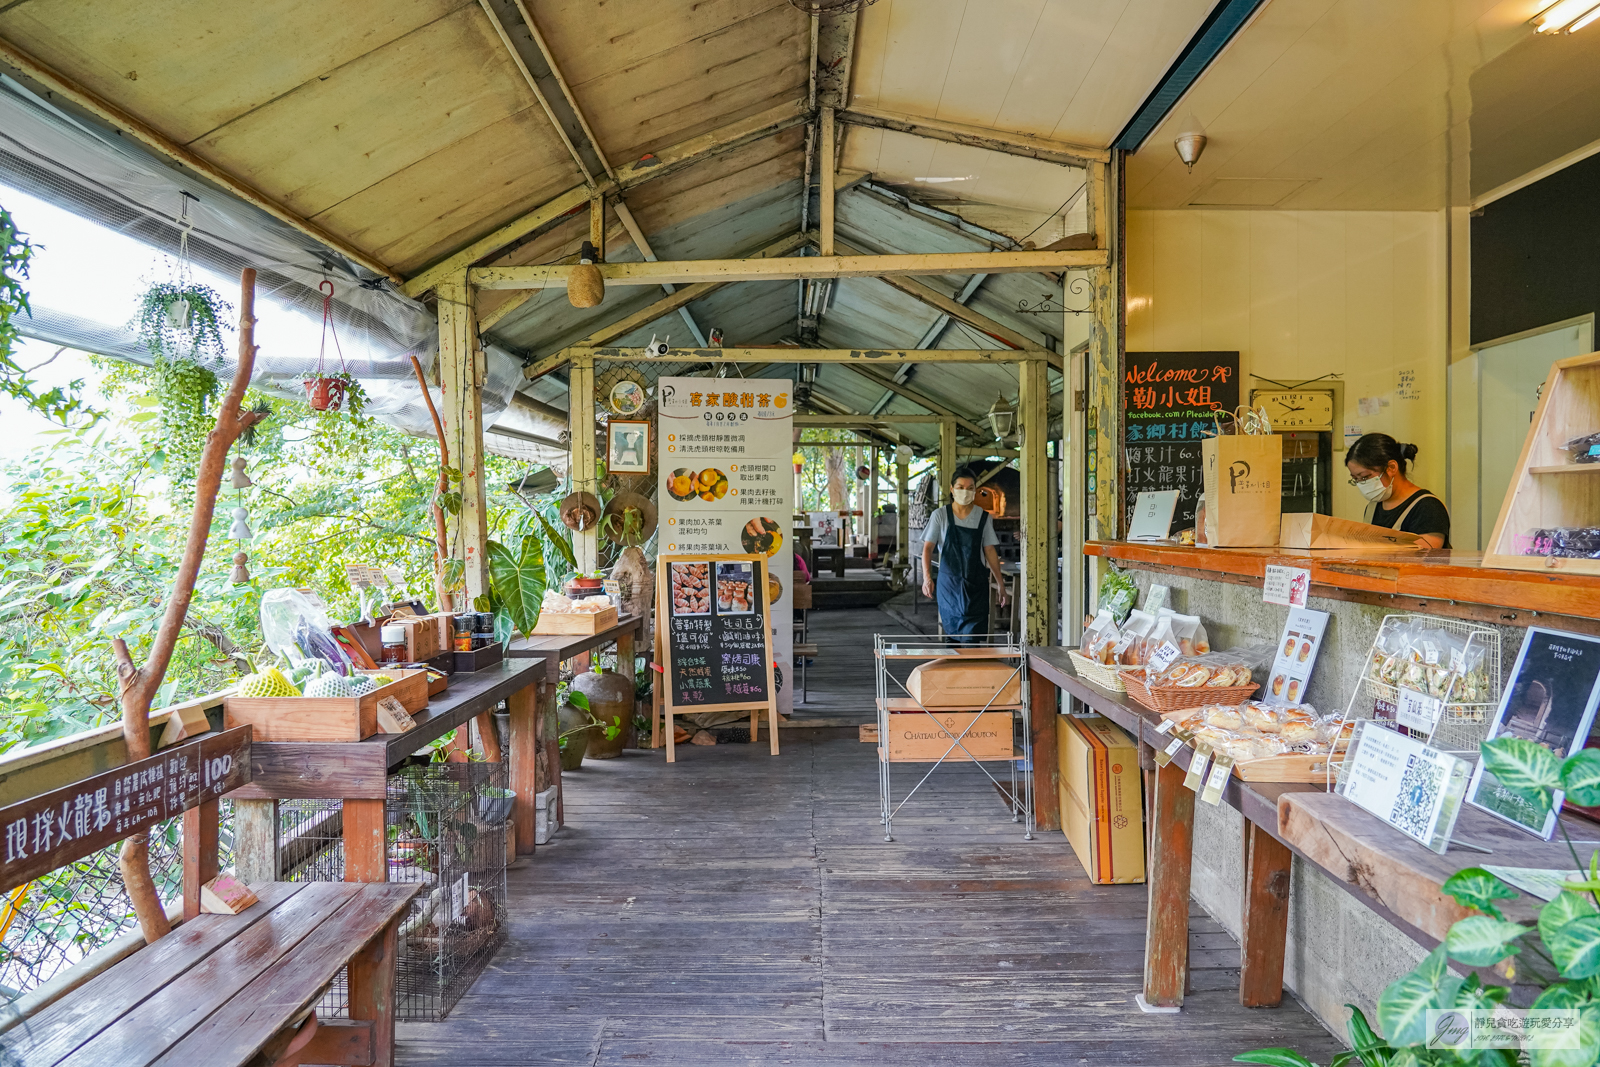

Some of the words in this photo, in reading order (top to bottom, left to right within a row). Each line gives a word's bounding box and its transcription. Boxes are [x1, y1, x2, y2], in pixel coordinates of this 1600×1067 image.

[1125, 362, 1208, 384] Welcome
[690, 392, 771, 408] 客家酸柑茶
[740, 489, 776, 497] 果肉去籽後
[679, 518, 722, 526] 果肉加入茶葉
[679, 528, 708, 536] 混和均勻
[205, 755, 232, 787] 100
[5, 787, 111, 864] 現採火龍果
